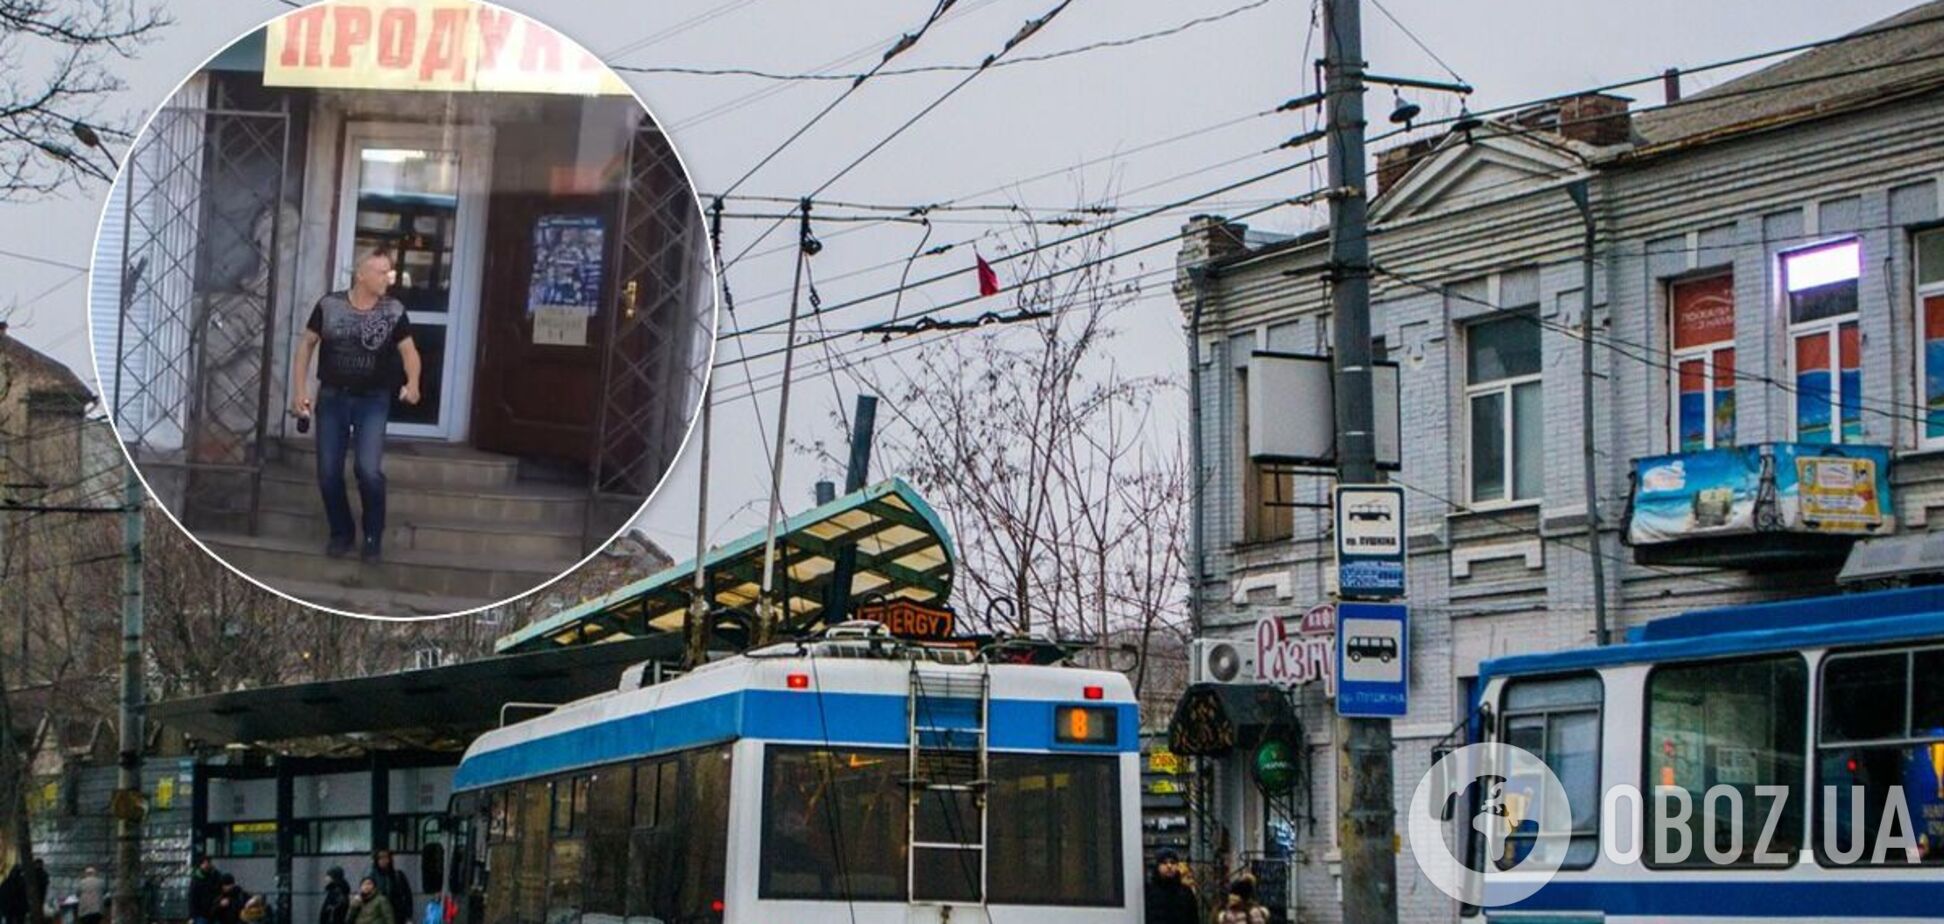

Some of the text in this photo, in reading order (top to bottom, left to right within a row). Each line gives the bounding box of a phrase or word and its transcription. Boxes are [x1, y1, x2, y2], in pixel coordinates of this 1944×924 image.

[280, 4, 601, 81] ПРОДУК
[1360, 536, 1396, 546] ПУШКІНА
[1070, 708, 1088, 740] 8
